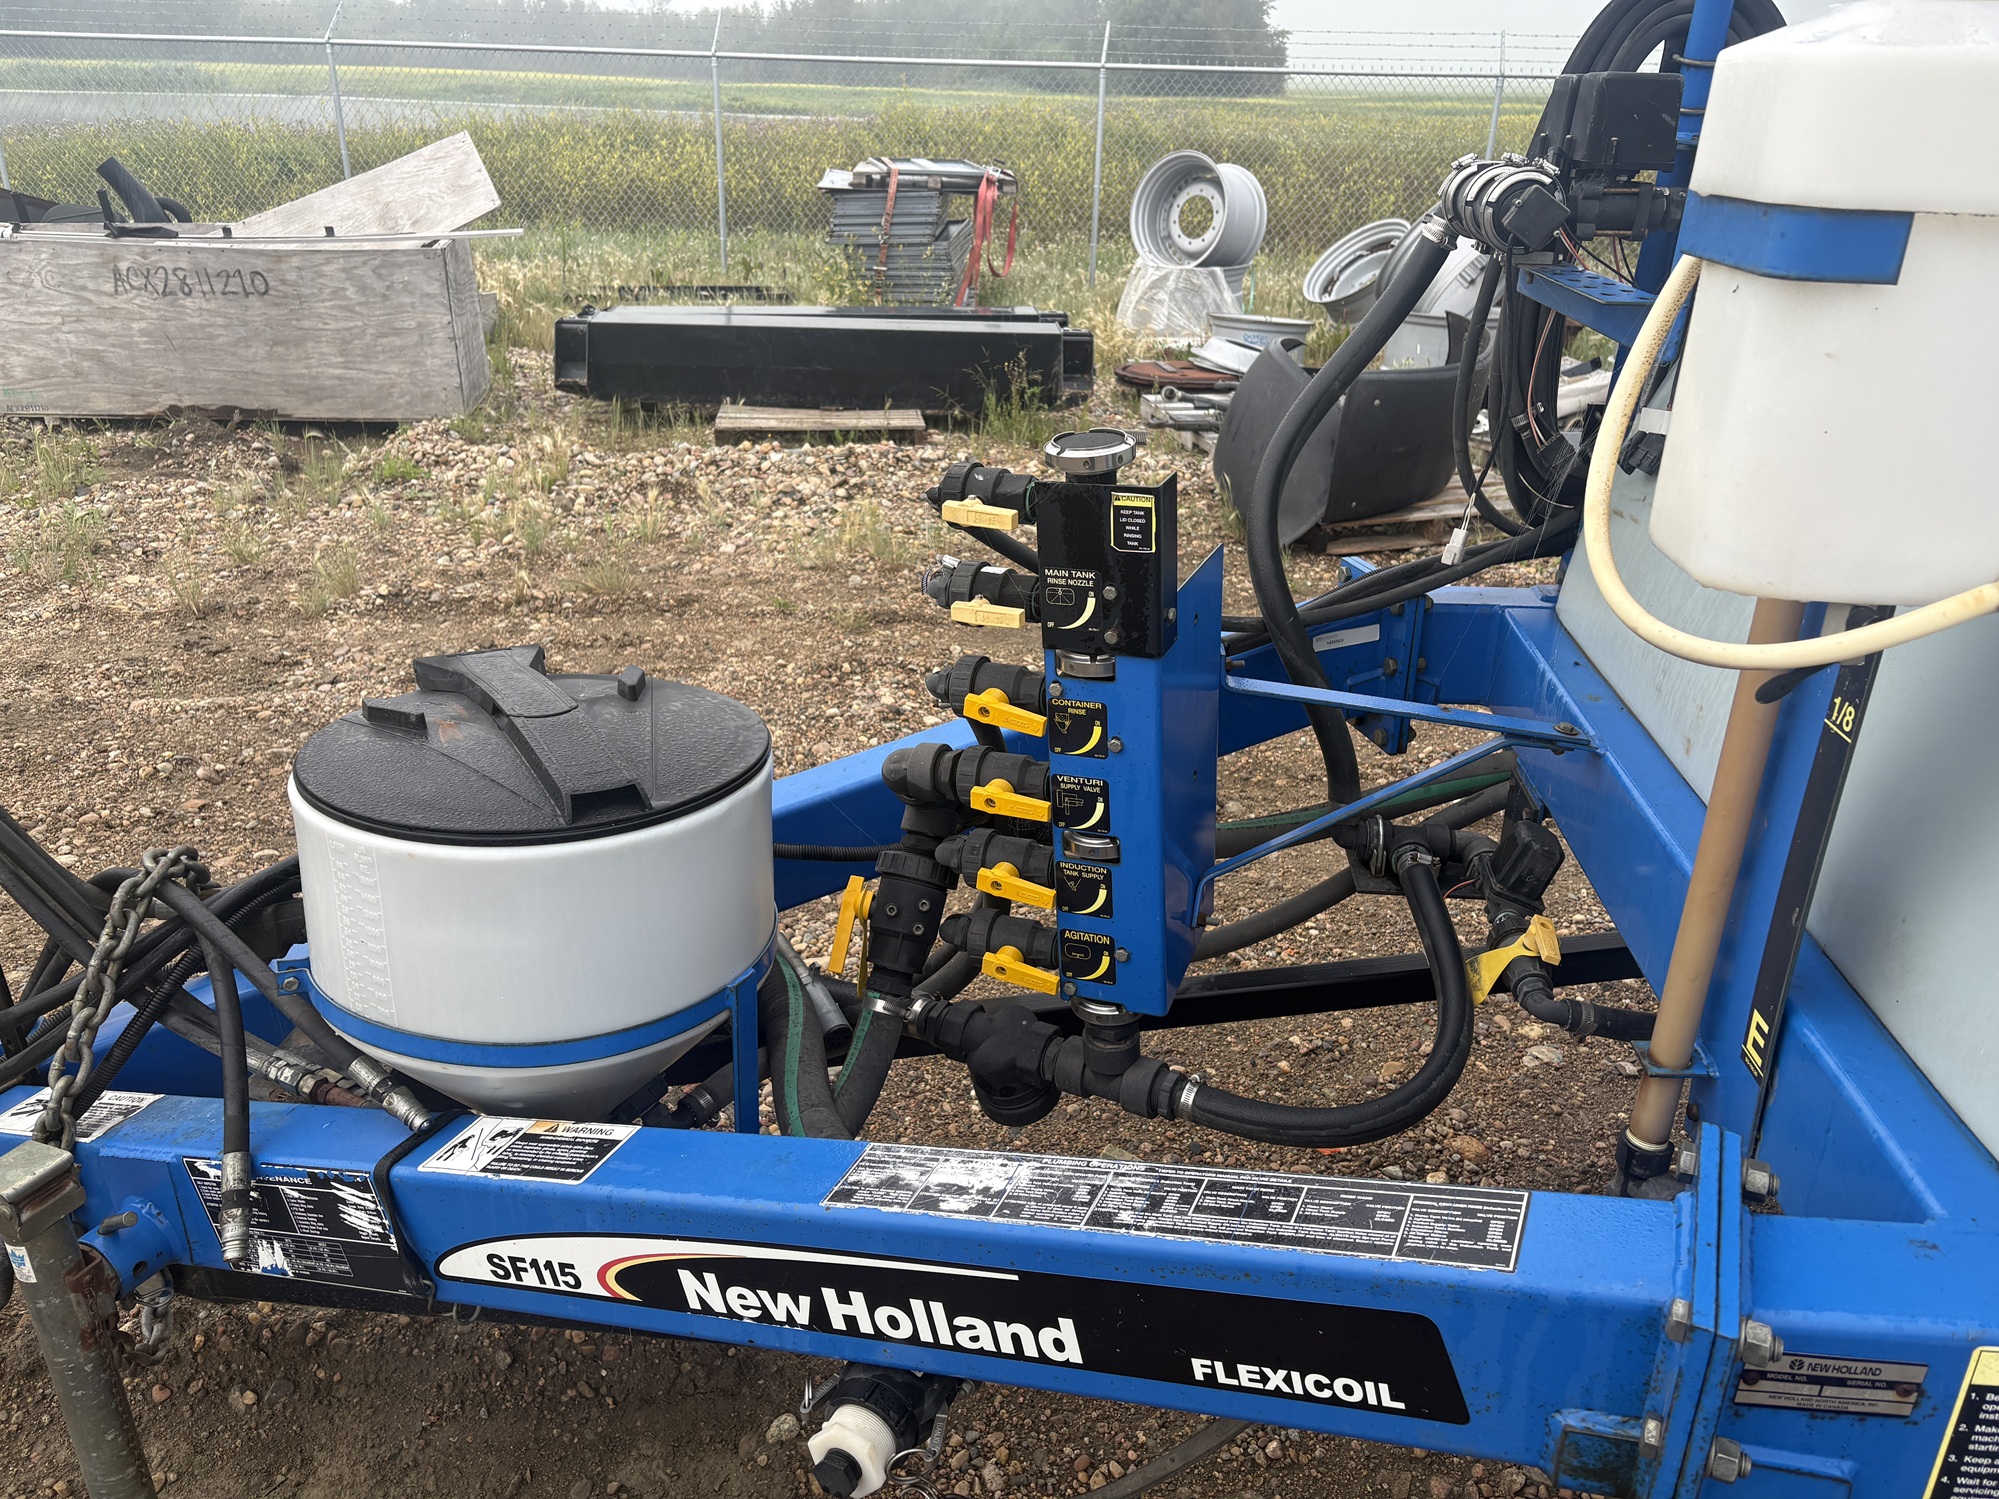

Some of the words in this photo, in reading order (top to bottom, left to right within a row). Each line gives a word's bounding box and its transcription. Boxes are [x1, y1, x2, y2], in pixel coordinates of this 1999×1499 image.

[112, 264, 270, 299] ACX2811210
[1121, 495, 1151, 503] CAUTION
[1044, 568, 1069, 578] MAIN
[1070, 570, 1096, 579] TANK
[1067, 579, 1094, 587] NOZZLE
[1052, 698, 1102, 710] CONTAINER
[1067, 707, 1087, 716] RINSE
[1832, 697, 1855, 732] 1/8
[1056, 775, 1103, 786] VENTURI
[1060, 783, 1080, 791] SUPPLY
[1060, 862, 1107, 874] INDUCTION
[1063, 869, 1079, 877] TANK
[1081, 872, 1104, 880] SUPPLY
[1064, 930, 1110, 945] AGITATION
[1746, 1008, 1770, 1068] E
[108, 1094, 147, 1104] CAUTION
[561, 1125, 614, 1136] WARNING
[1042, 1158, 1087, 1167] PLUMBING
[1089, 1160, 1146, 1171] OPERATIONS
[486, 1253, 582, 1290] SF115
[677, 1268, 811, 1325] New
[820, 1287, 1083, 1364] Holland
[1807, 1362, 1832, 1374] NEW
[1832, 1364, 1882, 1377] HOLLAND
[1766, 1373, 1794, 1381] MODEL
[1190, 1357, 1406, 1410] FLEXICOIL
[1846, 1380, 1873, 1388] SERIAL
[1875, 1381, 1888, 1389] NO.
[1783, 1395, 1813, 1403] HOLLAND
[1970, 1392, 1979, 1400] 1.
[1958, 1423, 1969, 1432] 2.
[1948, 1454, 1958, 1462] 3.
[1963, 1455, 1992, 1465] Keep
[1940, 1475, 1950, 1484] 4.
[1956, 1476, 1980, 1486] Wait
[1982, 1478, 1998, 1487] for
[1953, 1486, 1999, 1497] servicing
